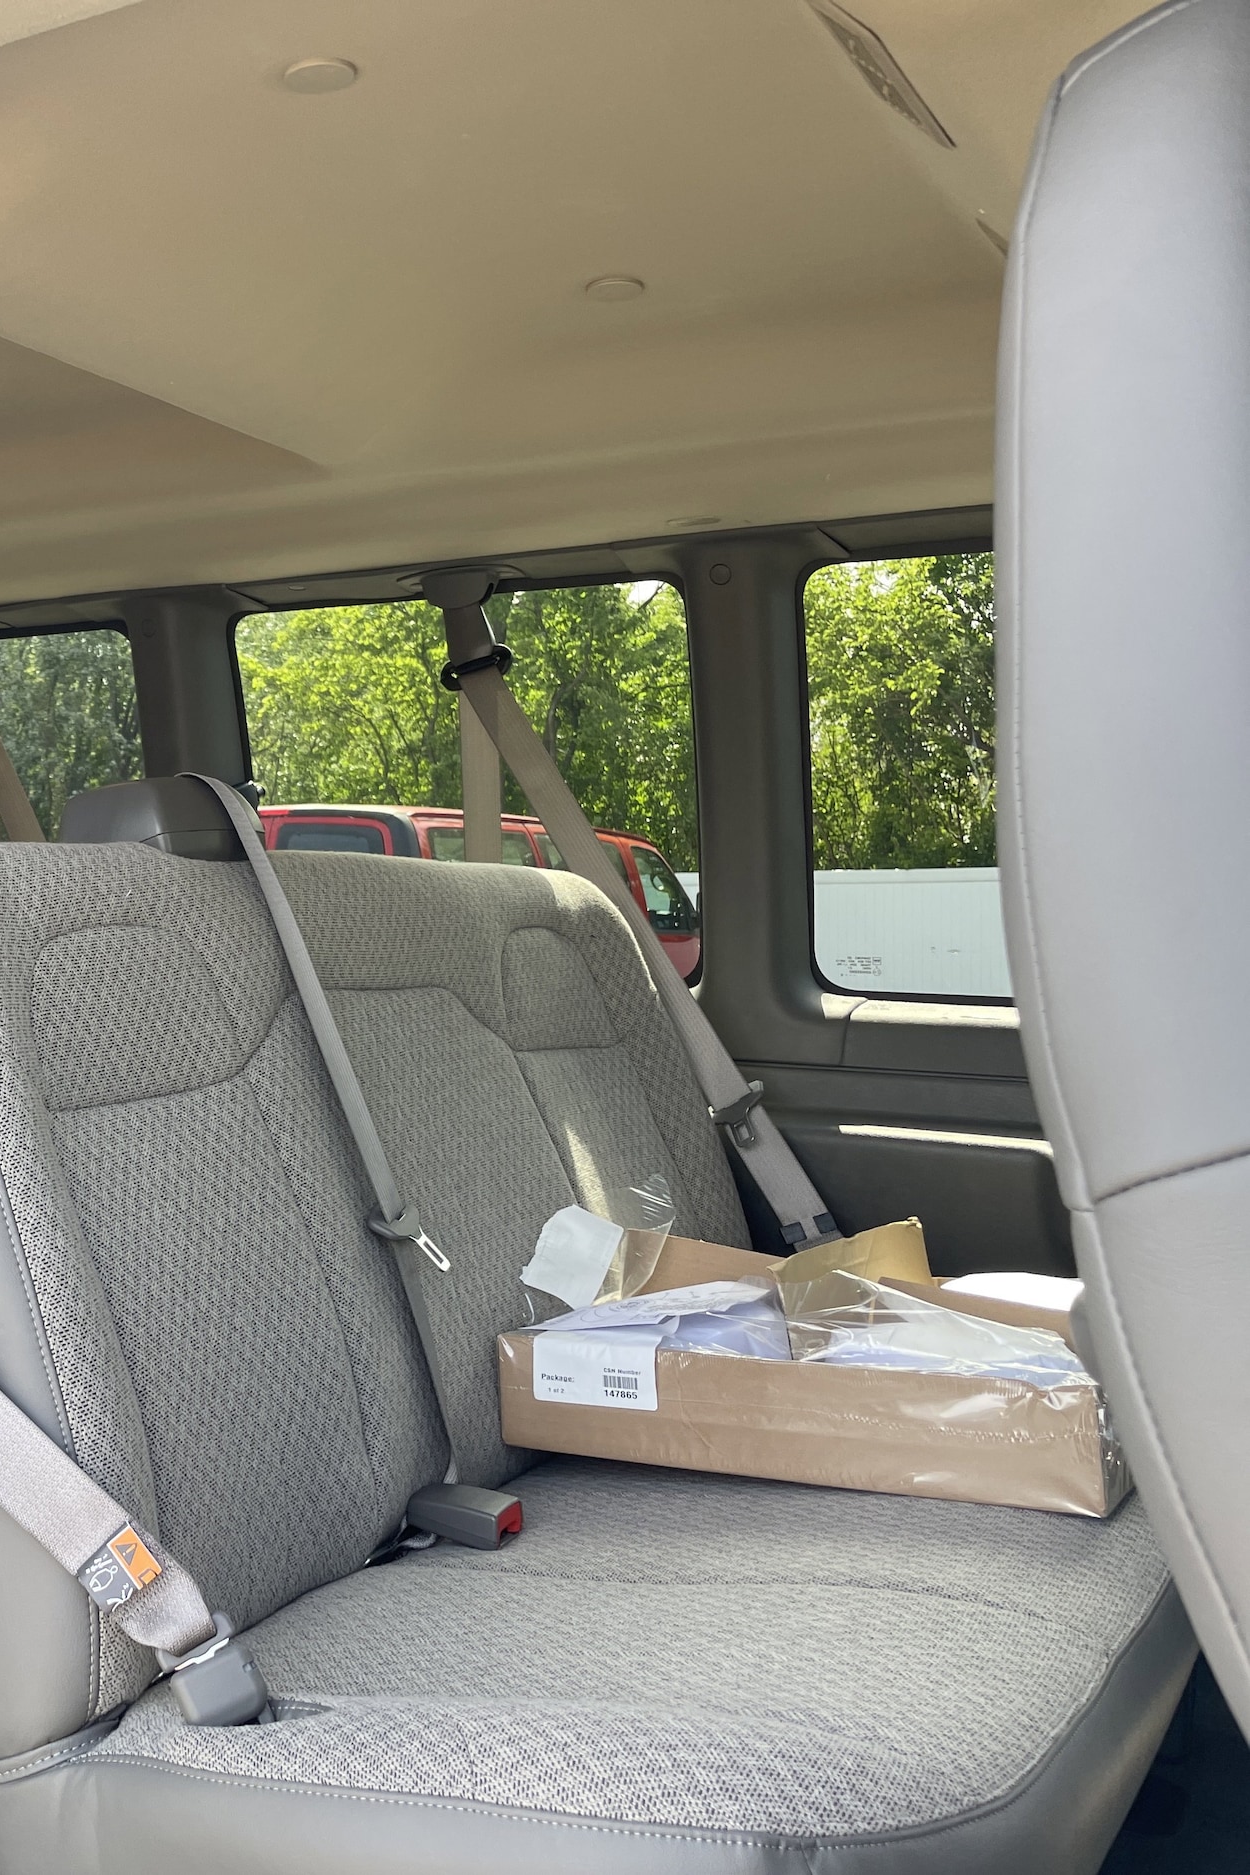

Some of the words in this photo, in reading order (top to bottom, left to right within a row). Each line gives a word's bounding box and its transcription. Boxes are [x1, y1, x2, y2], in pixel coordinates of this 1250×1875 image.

[617, 1368, 641, 1376] Number
[541, 1373, 575, 1383] Package:
[604, 1389, 638, 1399] 147865
